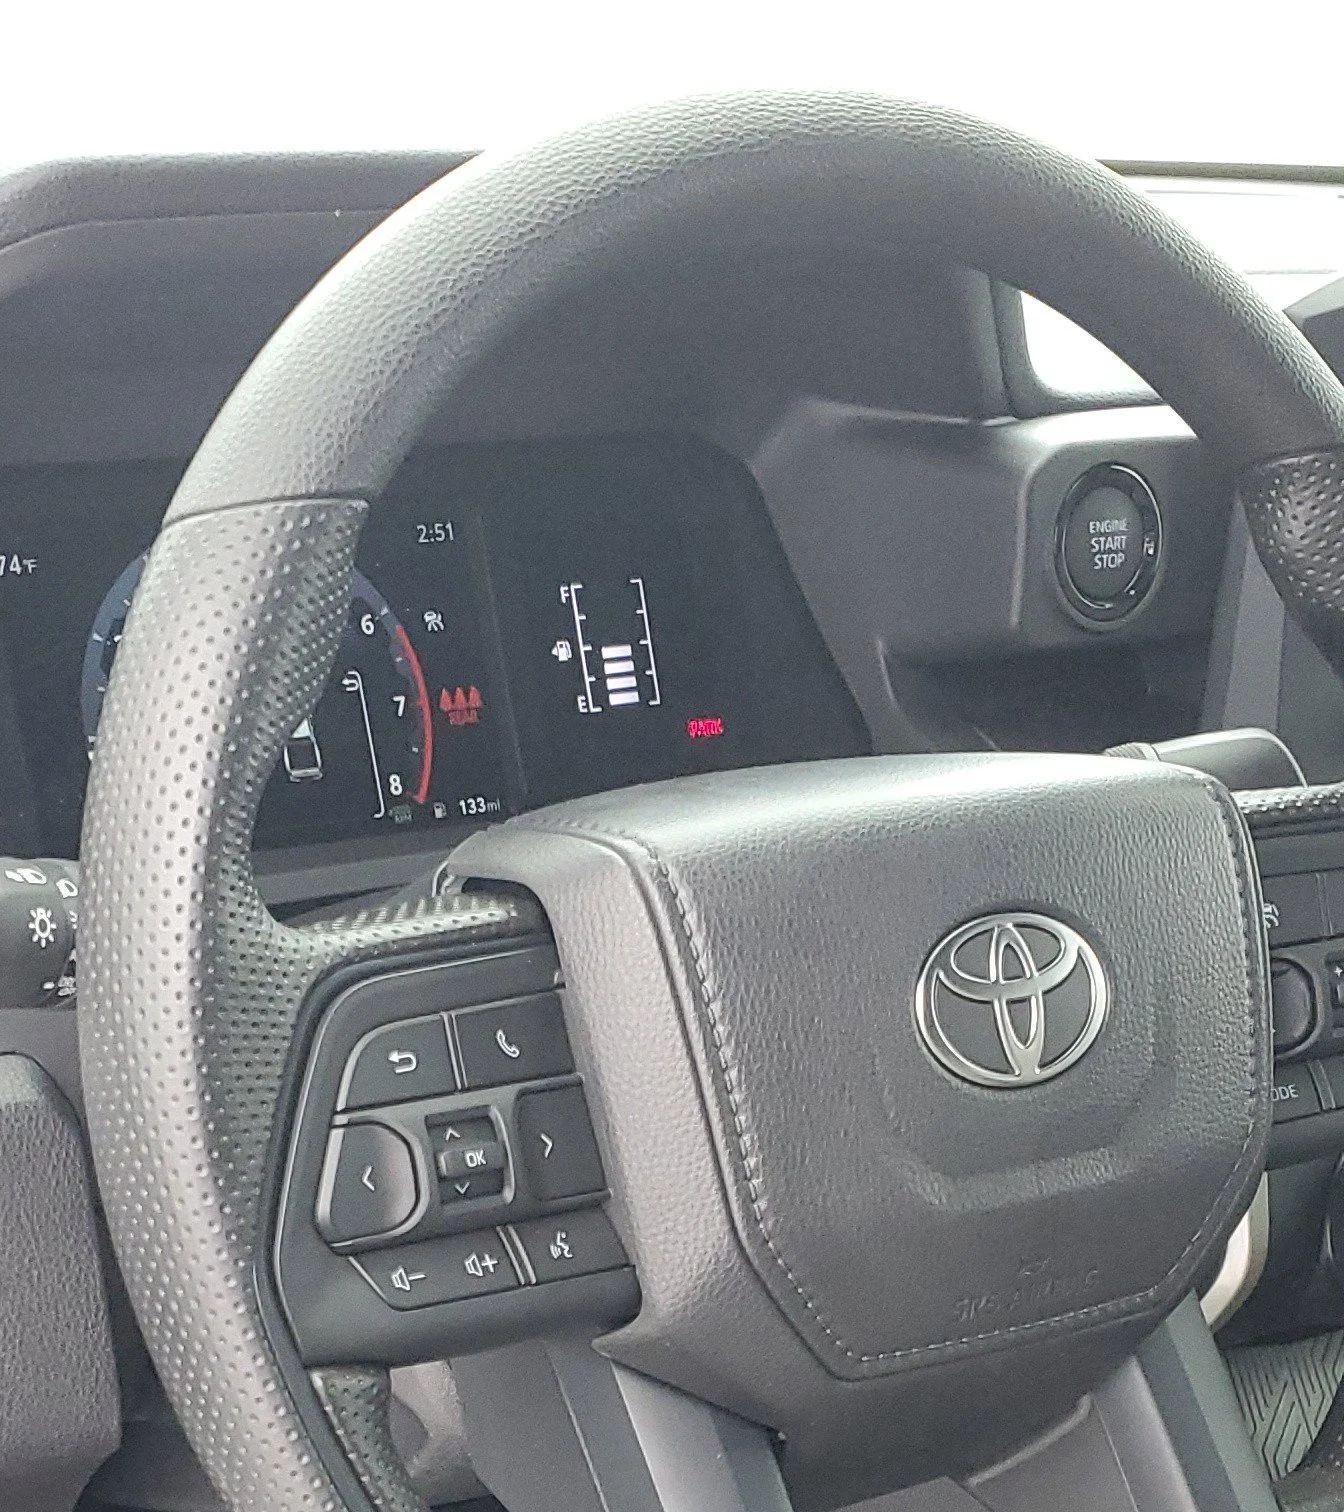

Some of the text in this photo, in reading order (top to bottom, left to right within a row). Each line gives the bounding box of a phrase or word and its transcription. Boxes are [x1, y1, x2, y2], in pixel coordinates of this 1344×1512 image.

[416, 520, 455, 544] 2:51
[1089, 519, 1128, 533] ENGINE
[1090, 536, 1127, 553] START
[1093, 553, 1125, 570] STOP
[560, 587, 569, 603] F
[360, 613, 375, 635] 6
[393, 696, 405, 717] 7
[577, 695, 588, 713] E
[389, 773, 402, 796] 8
[465, 1150, 487, 1168] OK
